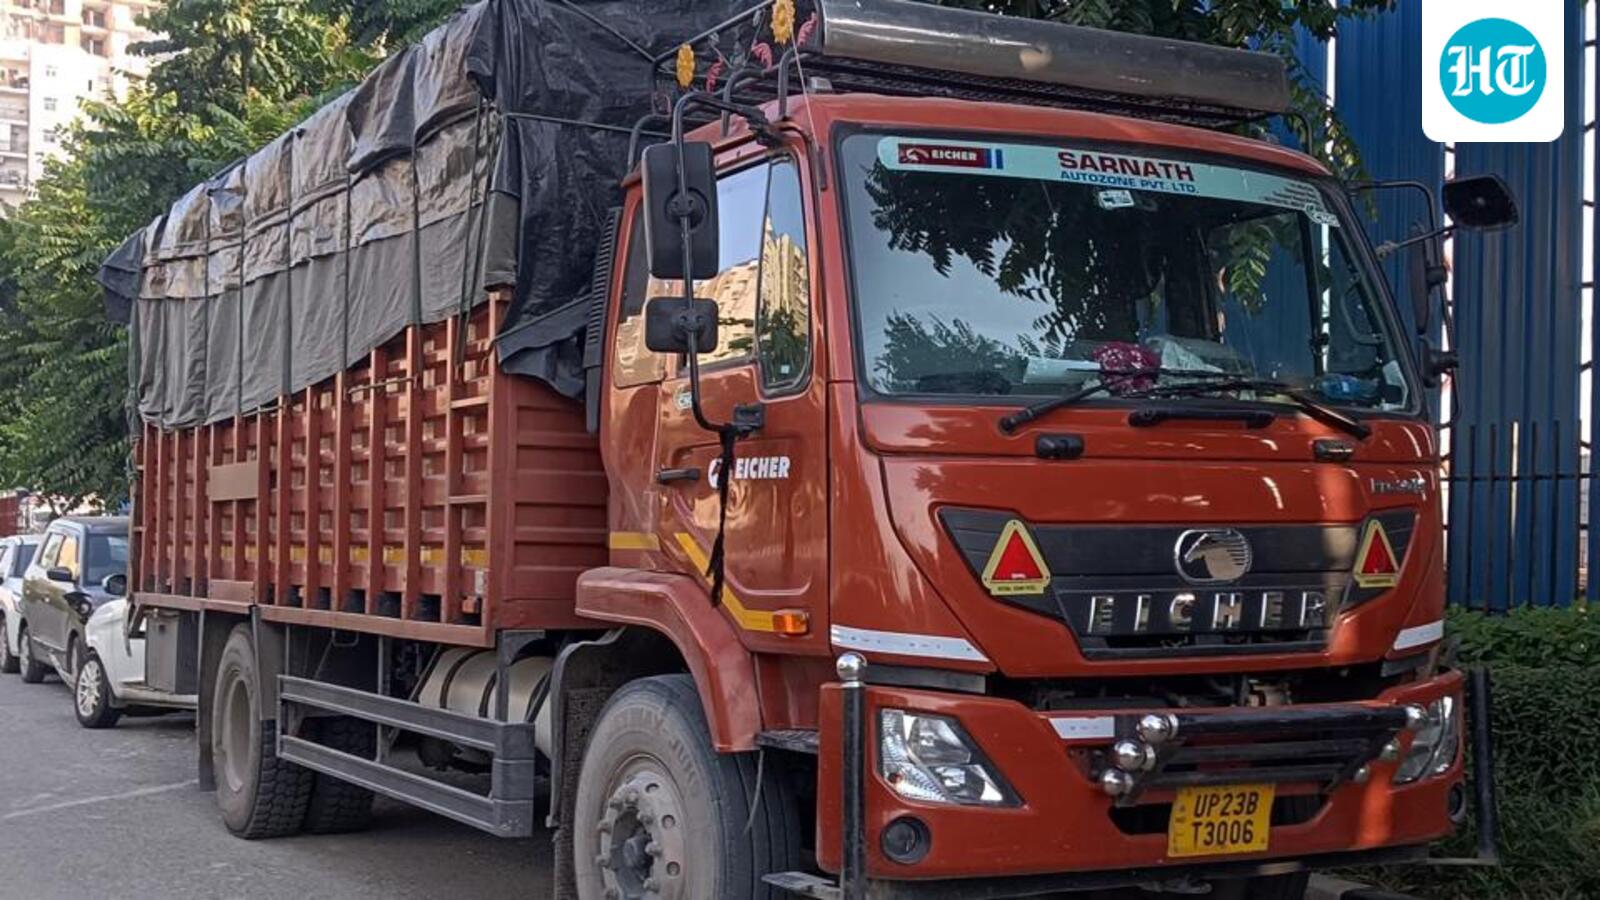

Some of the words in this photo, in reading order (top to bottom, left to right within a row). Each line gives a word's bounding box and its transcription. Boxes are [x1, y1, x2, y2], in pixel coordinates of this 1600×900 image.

[931, 149, 977, 161] EICHER
[1058, 152, 1195, 181] SARNATH
[1061, 171, 1136, 187] AUTOZONE
[1172, 181, 1200, 194] LTD.
[735, 456, 791, 479] EICHER
[1087, 592, 1327, 633] EICHER
[1193, 791, 1259, 818] UP23B
[1191, 820, 1254, 848] T3006
